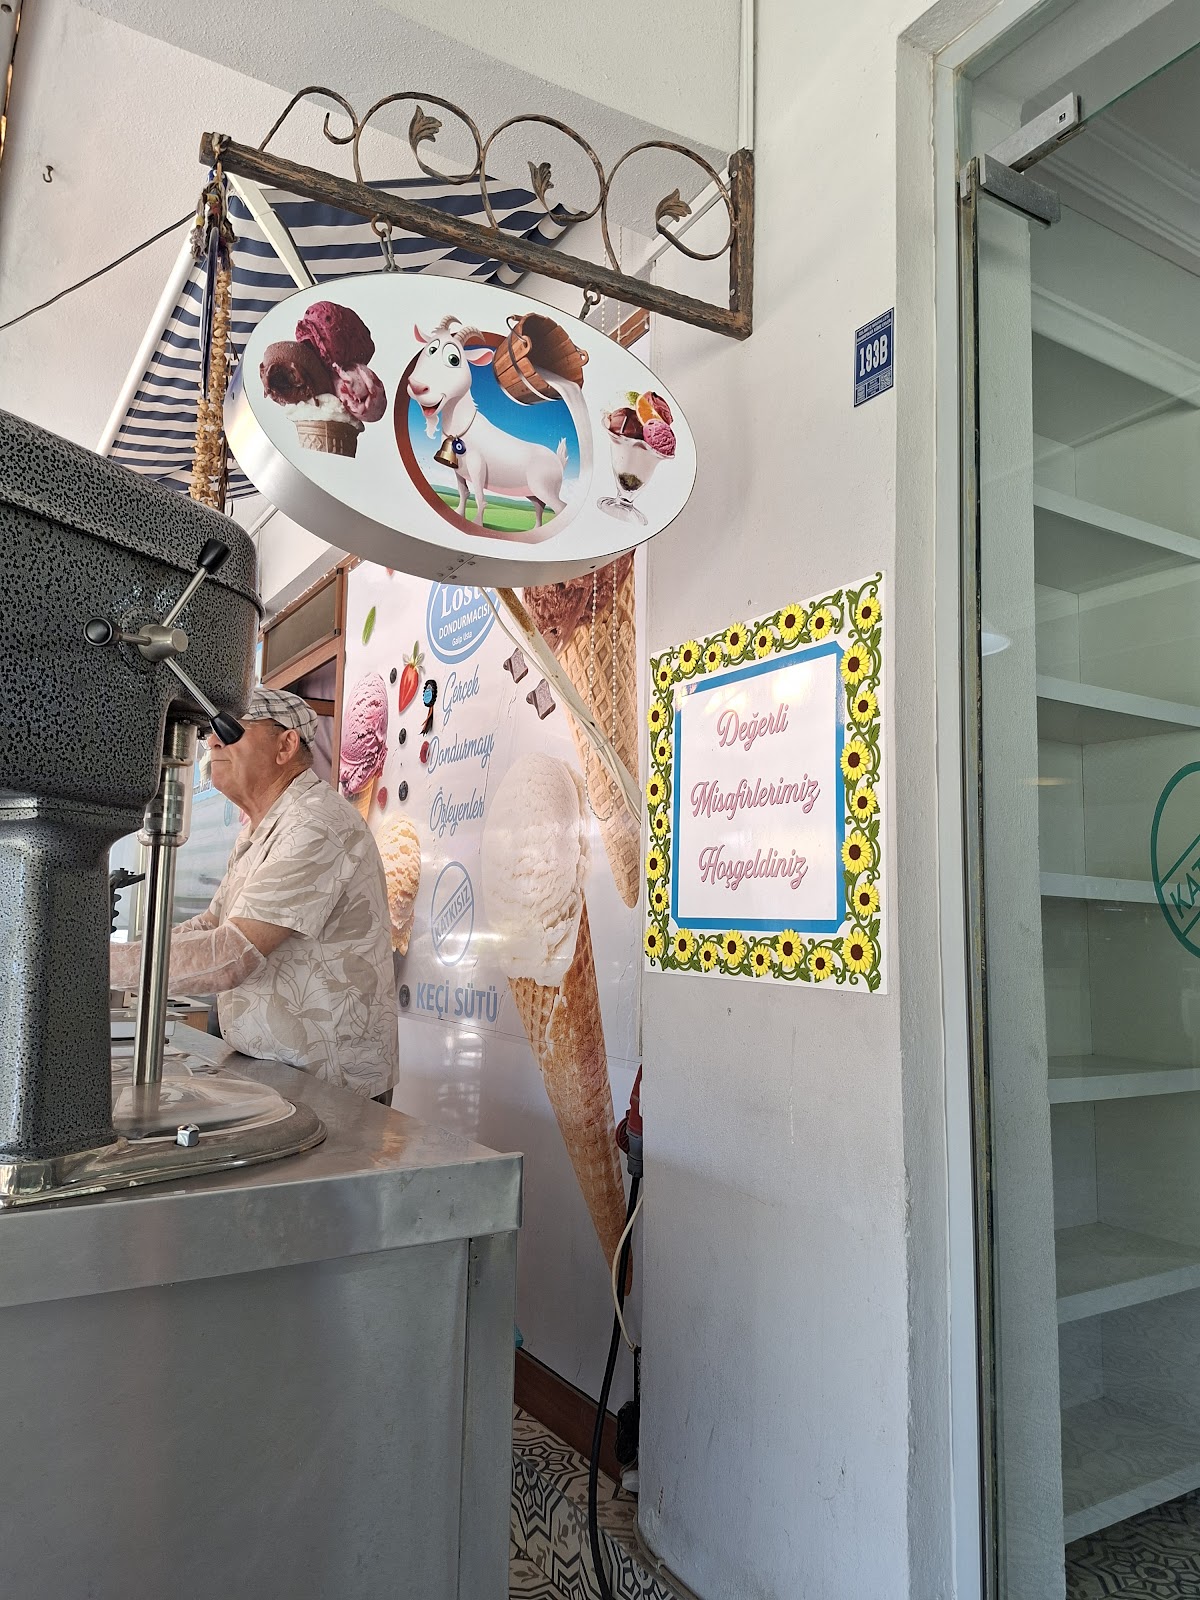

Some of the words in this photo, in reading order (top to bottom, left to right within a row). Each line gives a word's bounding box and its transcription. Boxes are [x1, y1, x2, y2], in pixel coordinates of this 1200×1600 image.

[859, 334, 888, 377] 193B
[438, 603, 491, 640] DONDURMACISI
[442, 663, 480, 727] Gerçek
[716, 702, 790, 752] Değerli
[427, 733, 495, 774] Dondurmayı
[429, 786, 485, 838] Özleyenler
[690, 773, 821, 820] Misafirlerimiz
[698, 844, 809, 891] Hoşgeldiniz
[434, 885, 471, 942] KATKISIZ
[416, 979, 450, 1020] KEÇİ
[453, 982, 498, 1023] SÜTÜ
